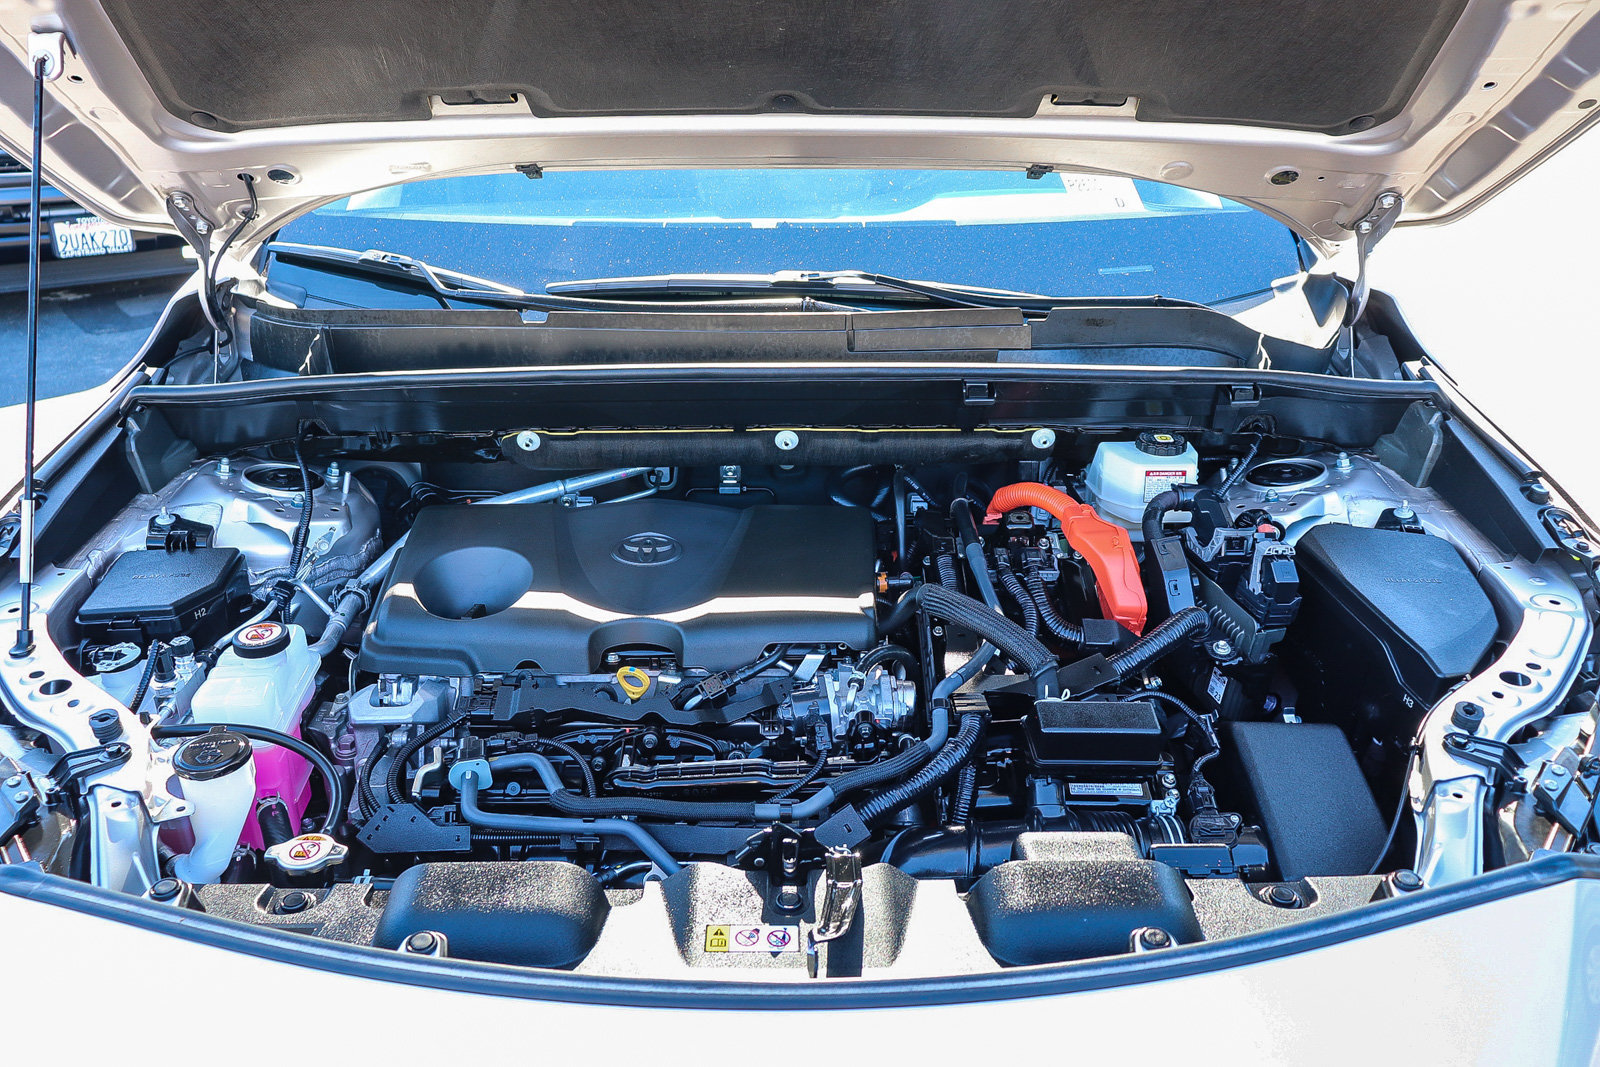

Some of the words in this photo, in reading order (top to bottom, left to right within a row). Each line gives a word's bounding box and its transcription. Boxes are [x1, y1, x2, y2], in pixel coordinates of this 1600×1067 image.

[60, 229, 128, 252] 9UAK270
[60, 246, 106, 258] CAPISTRANO
[194, 607, 207, 620] H2
[1402, 693, 1414, 708] H3
